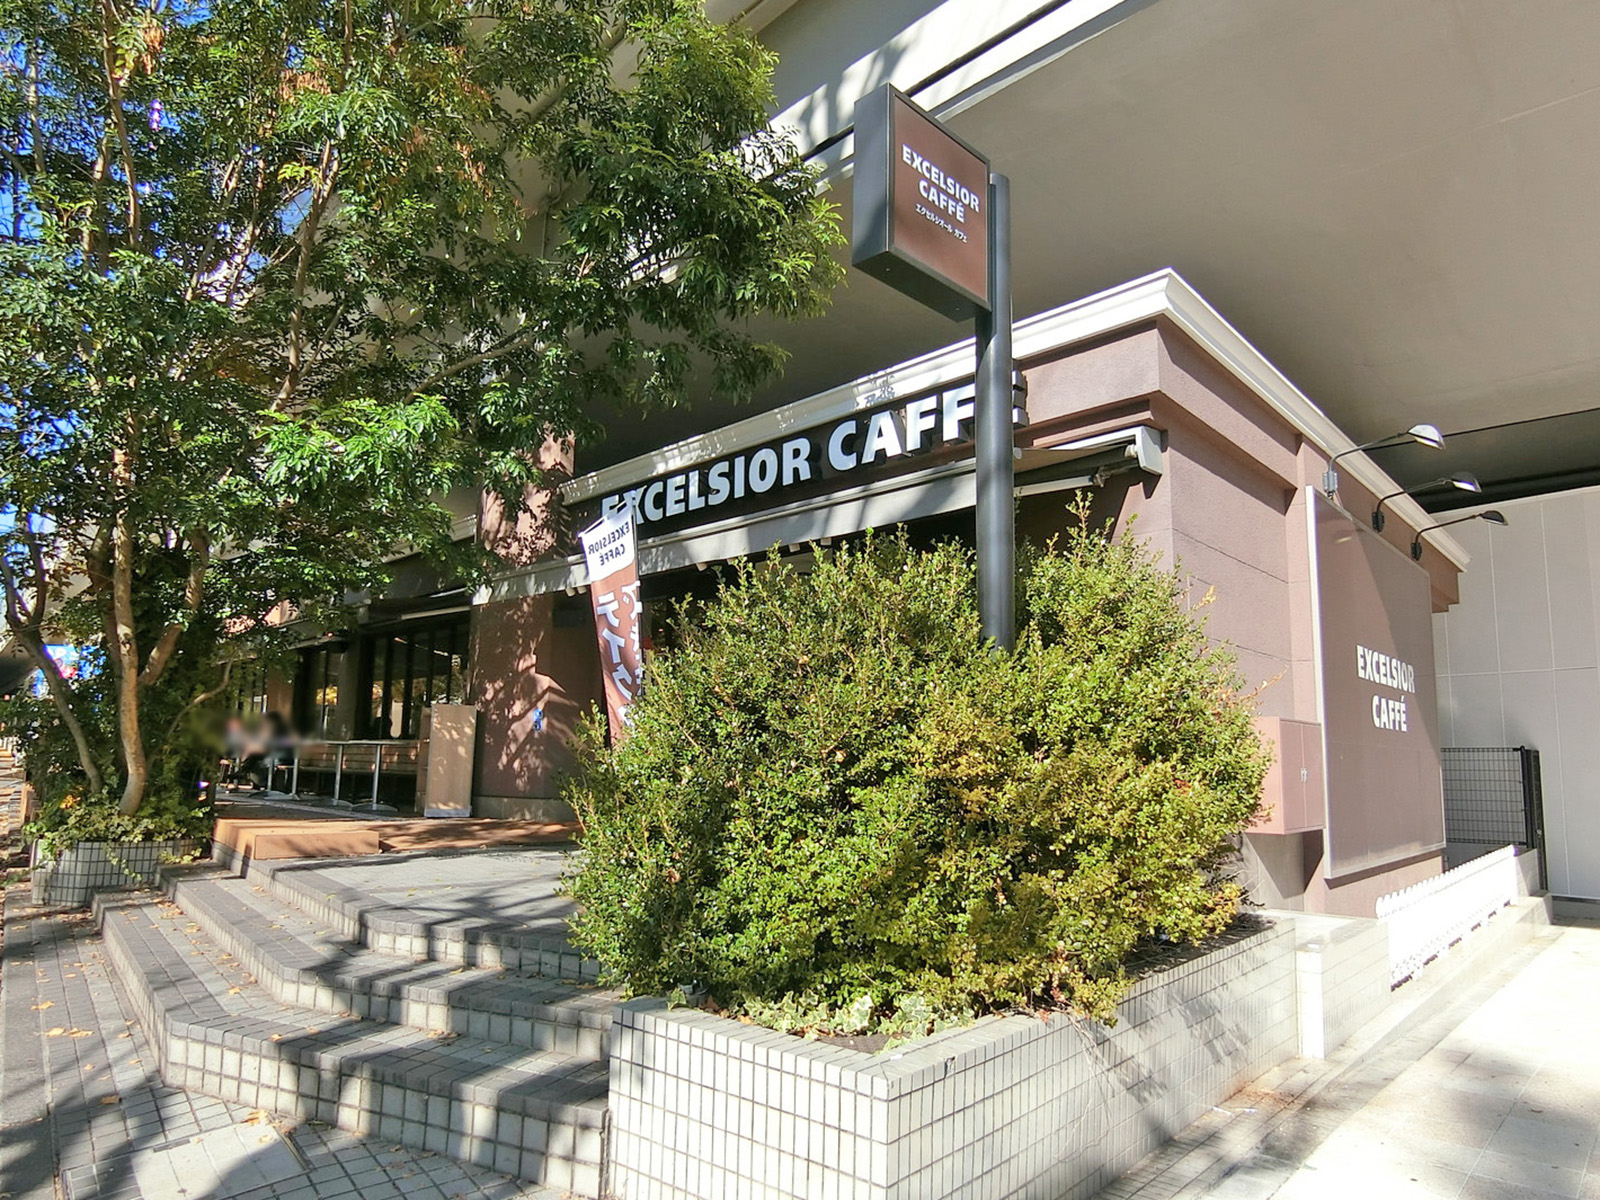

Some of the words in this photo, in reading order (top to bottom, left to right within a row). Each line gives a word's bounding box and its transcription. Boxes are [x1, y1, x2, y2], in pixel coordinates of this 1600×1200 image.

[902, 144, 980, 213] EXCELSIOR
[918, 179, 965, 223] CAFFÉ
[914, 203, 953, 233] エクセルシオール
[602, 437, 811, 525] EXCELSIOR
[827, 369, 1018, 472] CAFF
[1356, 644, 1415, 693] EXCELSIOR
[1372, 694, 1408, 732] CAFFÉ
